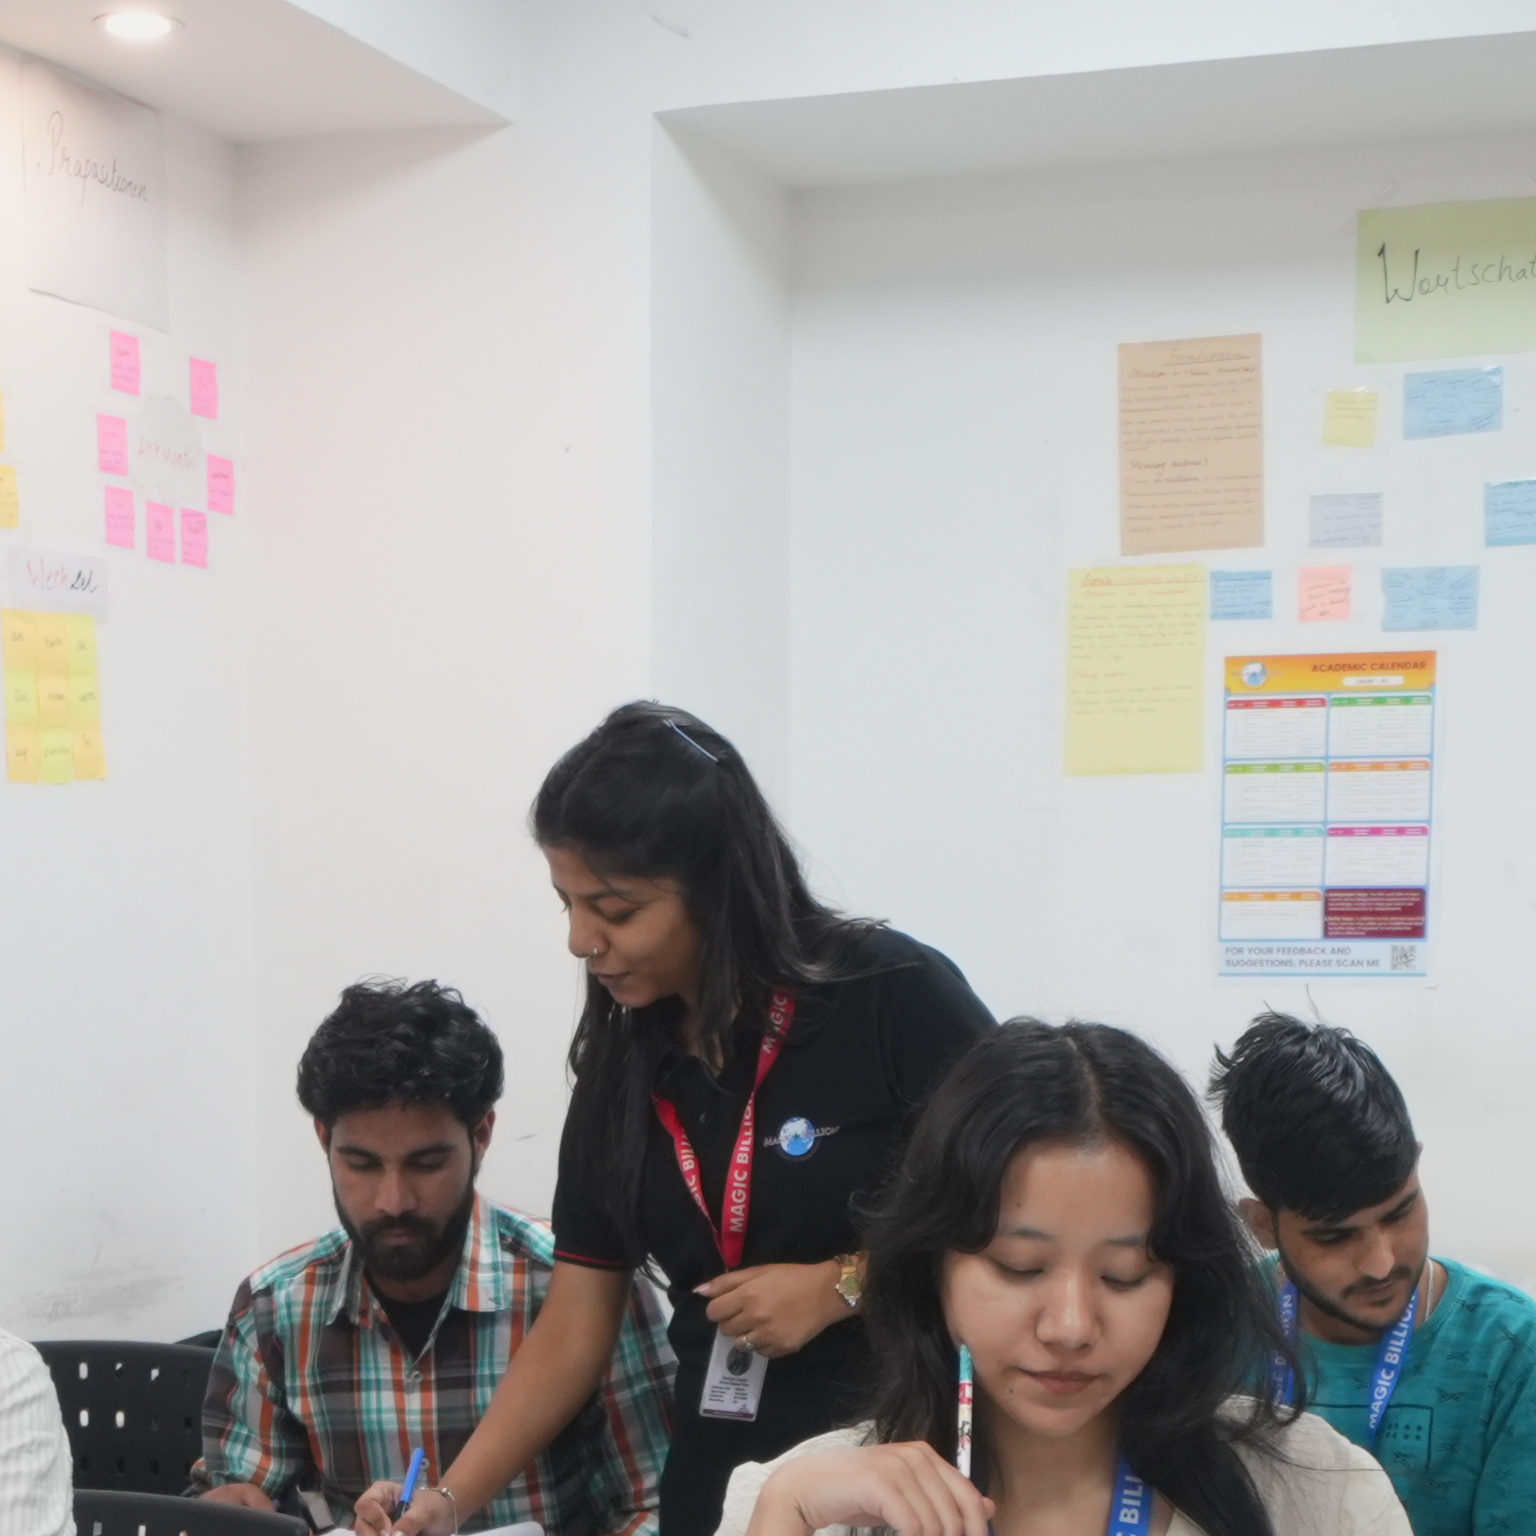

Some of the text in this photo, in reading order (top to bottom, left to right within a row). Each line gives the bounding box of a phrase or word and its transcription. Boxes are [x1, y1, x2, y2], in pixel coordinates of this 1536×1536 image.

[1312, 661, 1427, 673] ACADEMIC CALENDAR
[1226, 946, 1352, 956] FOR YOUR FEEDBACK AND
[1299, 959, 1333, 968] PLEASE
[1336, 959, 1364, 968] SCAN
[1367, 959, 1381, 968] ME
[730, 1097, 753, 1233] MAGIC BILLIO
[1370, 1368, 1395, 1429] MAGIC
